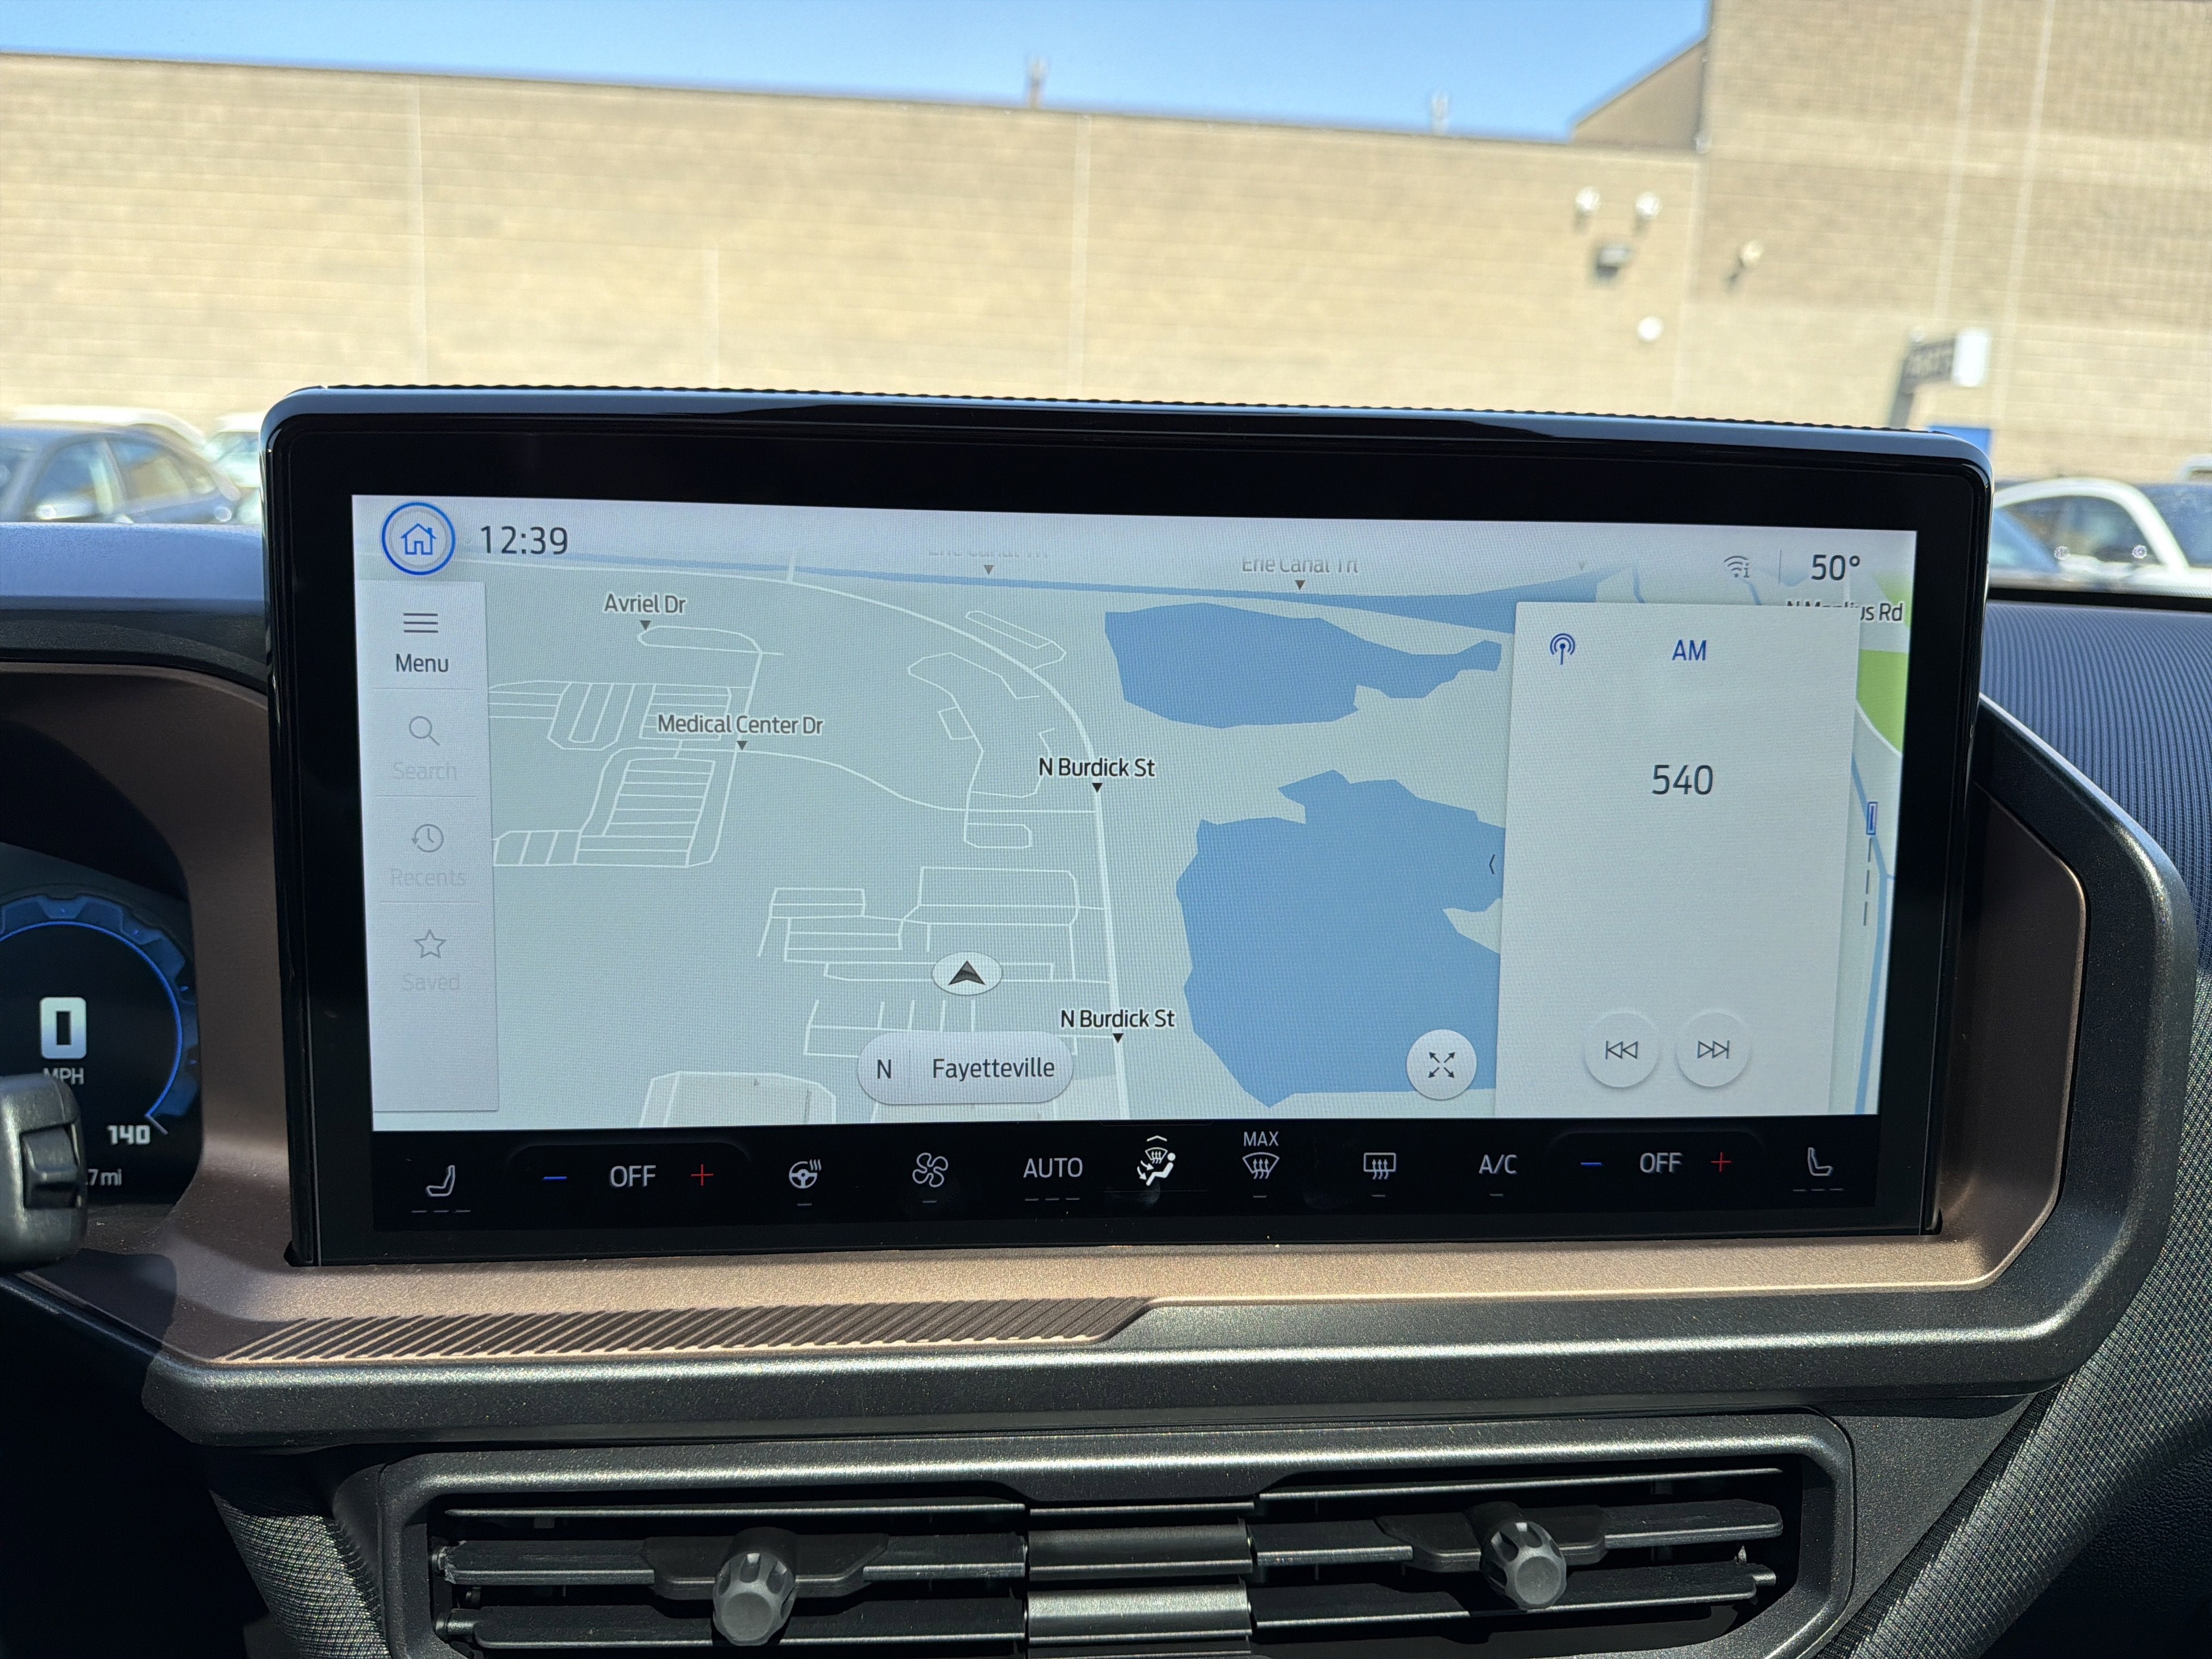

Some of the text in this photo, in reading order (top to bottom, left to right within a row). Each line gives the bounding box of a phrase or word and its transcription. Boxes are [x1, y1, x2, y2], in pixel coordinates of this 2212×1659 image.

[481, 526, 568, 555] 12:39
[1811, 554, 1861, 580] 50°
[604, 593, 686, 613] Avriel Dr
[1879, 602, 1903, 622] Rd
[1672, 639, 1707, 661] AM
[396, 653, 449, 673] Menu
[658, 714, 824, 734] Medical Center Dr
[394, 761, 457, 780] Search
[1039, 757, 1155, 777] N Burdick St
[1651, 764, 1713, 795] 540
[391, 868, 466, 887] Recents
[402, 973, 460, 991] Saved
[40, 997, 86, 1059] 0
[1061, 1009, 1175, 1028] N Burdick St
[877, 1057, 1055, 1082] N Fayetteville
[106, 1125, 150, 1145] 140
[1243, 1131, 1279, 1147] MAX
[1023, 1157, 1083, 1178] AUTO
[1479, 1154, 1517, 1175] A/C
[1639, 1152, 1683, 1173] OFF
[610, 1165, 656, 1187] OFF
